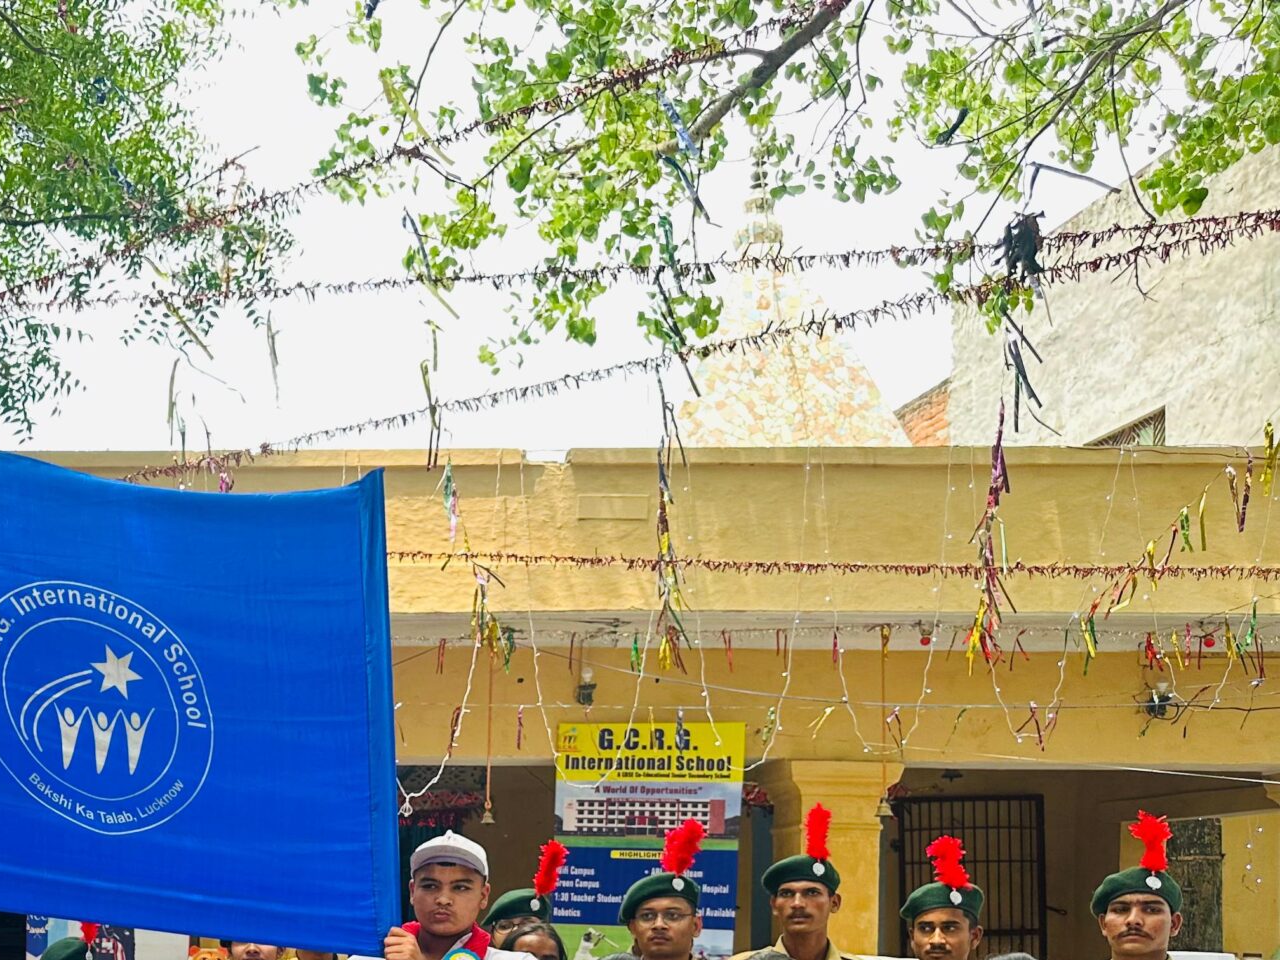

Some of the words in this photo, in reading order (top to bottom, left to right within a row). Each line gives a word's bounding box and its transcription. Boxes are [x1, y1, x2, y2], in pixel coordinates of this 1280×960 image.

[10, 588, 167, 644] International
[164, 642, 207, 729] School
[599, 729, 698, 750] G.C.R.G.
[565, 755, 671, 771] International
[676, 756, 731, 771] School
[602, 785, 627, 794] World
[630, 786, 638, 794] Of
[29, 772, 72, 810] Bakshi
[75, 804, 94, 820] Ka
[97, 810, 136, 824] Talab,
[138, 779, 184, 818] Lucknow
[570, 866, 595, 877] Campus
[575, 879, 599, 889] Campus
[702, 884, 729, 895] Hospital
[555, 893, 568, 901] 1:30
[571, 893, 595, 902] Teacher
[597, 894, 621, 903] Student
[553, 907, 580, 917] Robotics
[706, 908, 735, 918] Available
